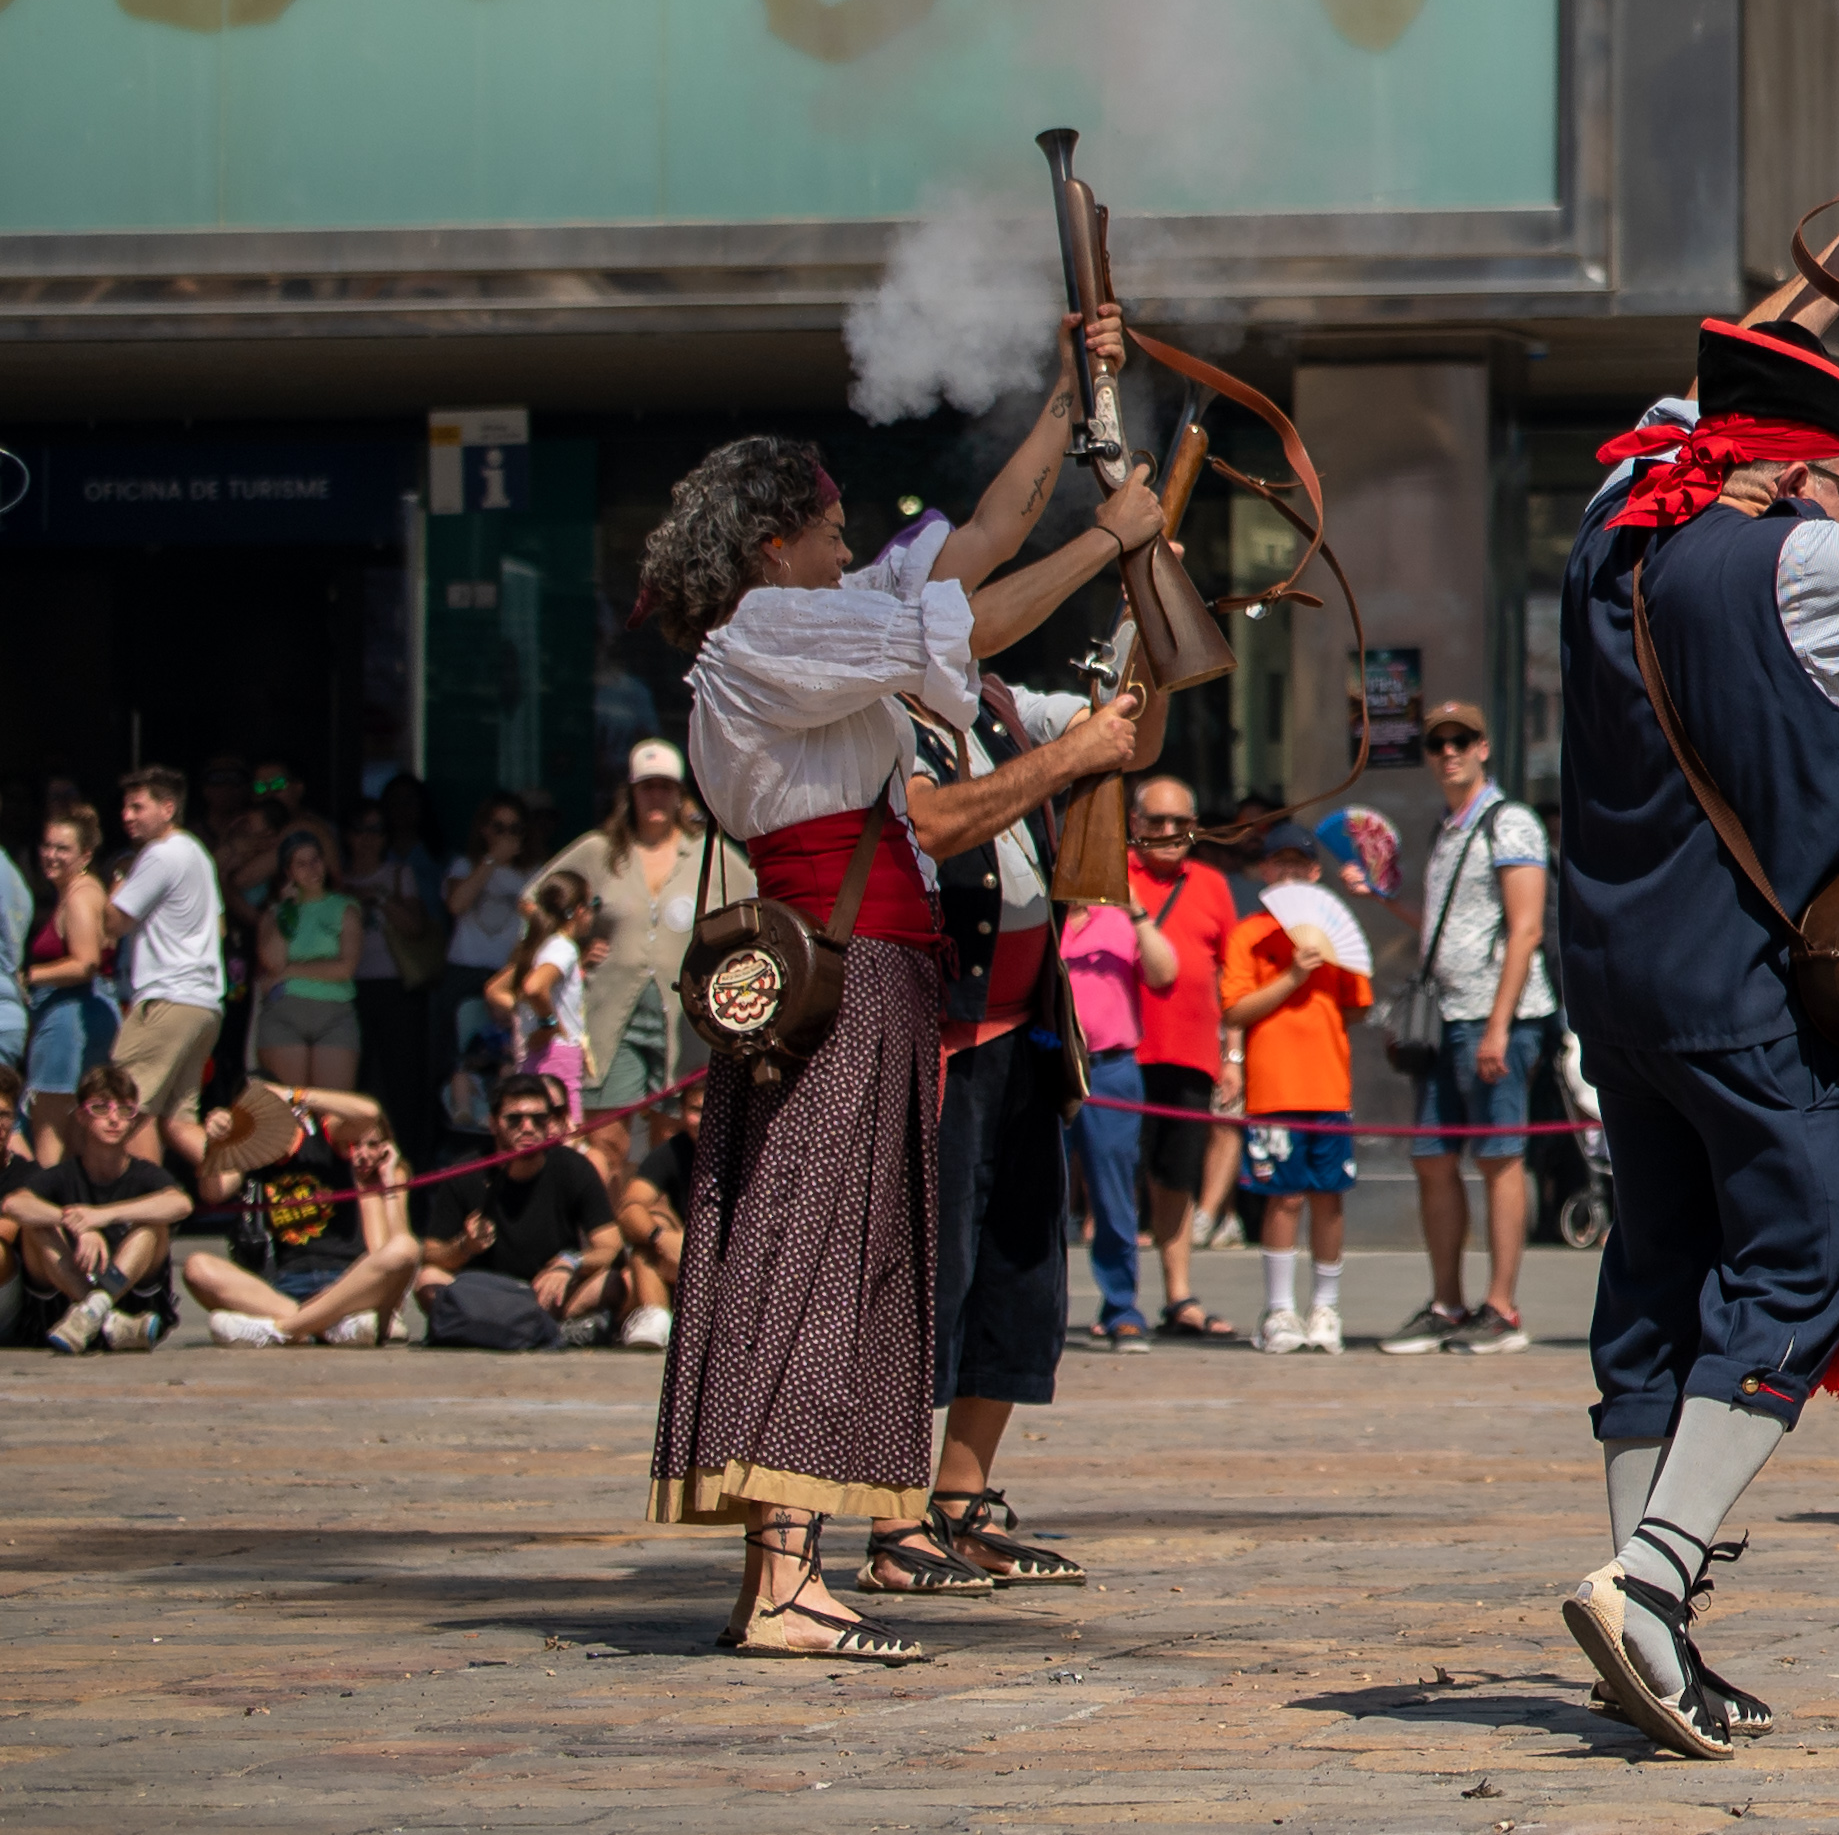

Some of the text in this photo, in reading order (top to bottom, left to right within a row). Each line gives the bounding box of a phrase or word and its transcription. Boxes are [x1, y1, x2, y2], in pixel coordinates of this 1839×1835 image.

[84, 477, 330, 502] OFICINA DE TURISME
